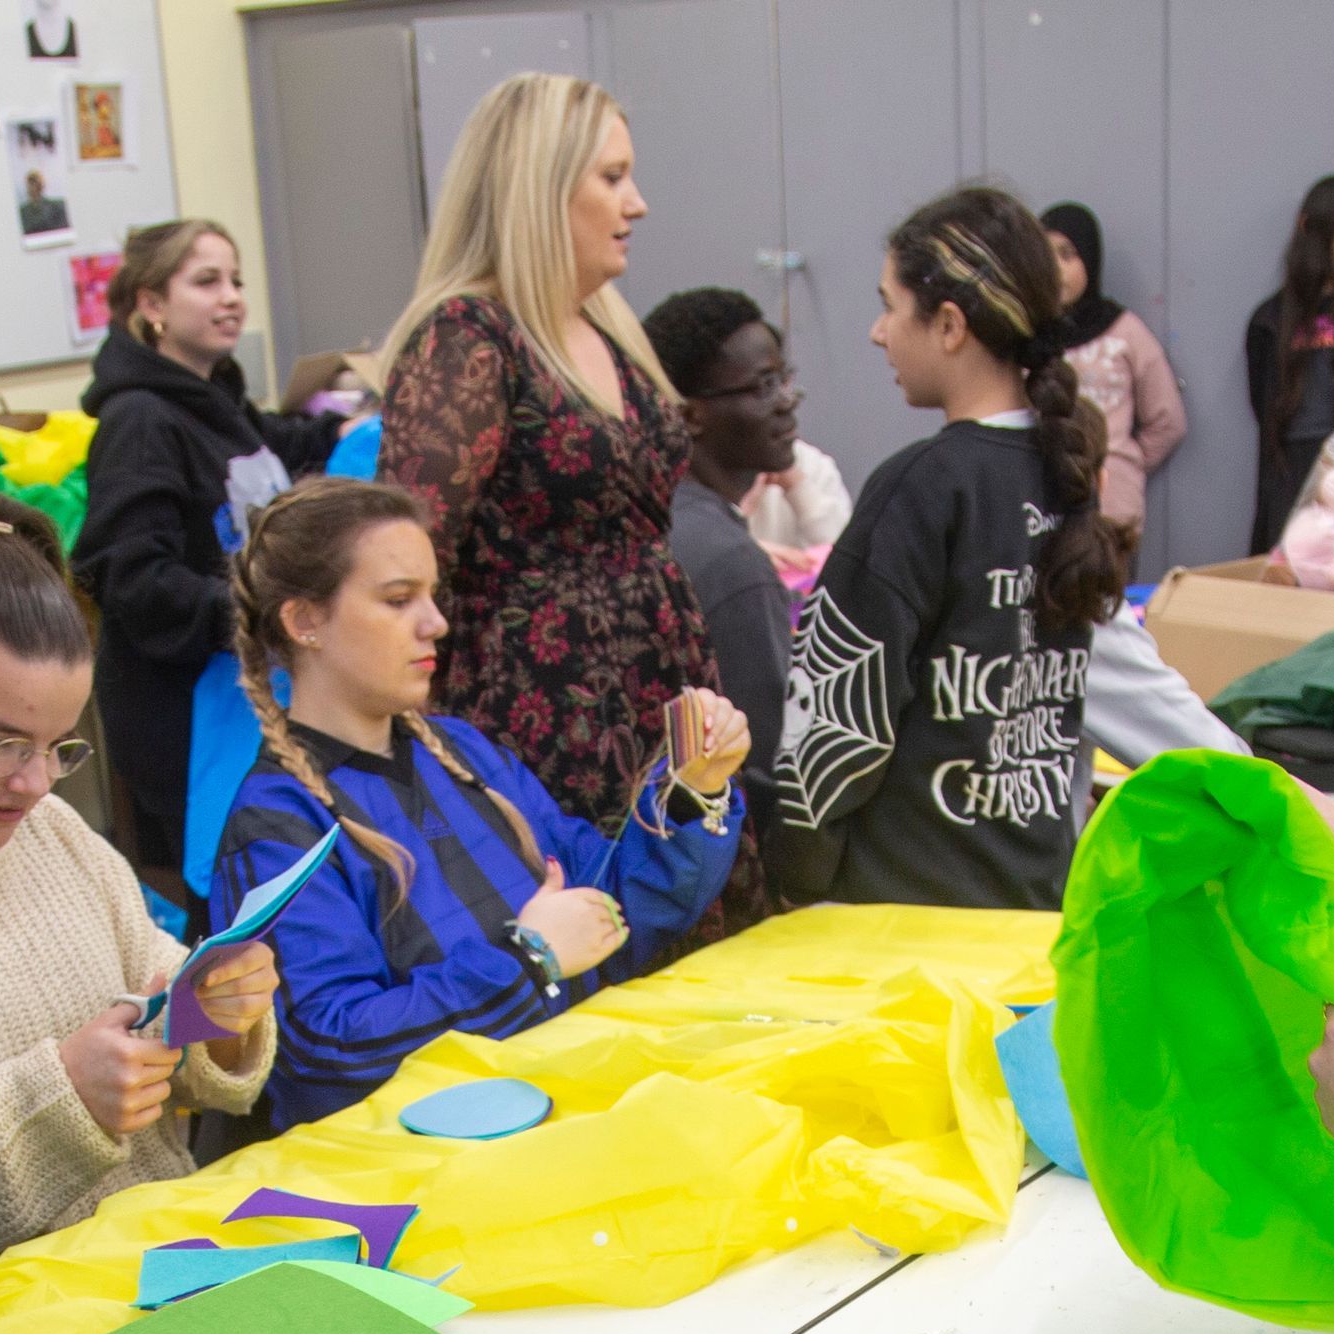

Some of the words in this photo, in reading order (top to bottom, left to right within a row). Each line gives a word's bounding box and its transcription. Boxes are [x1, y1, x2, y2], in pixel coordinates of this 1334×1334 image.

[931, 644, 1090, 721] NIGHMAR
[985, 705, 1080, 771] BEFORE
[931, 753, 1075, 828] CHRISTM
